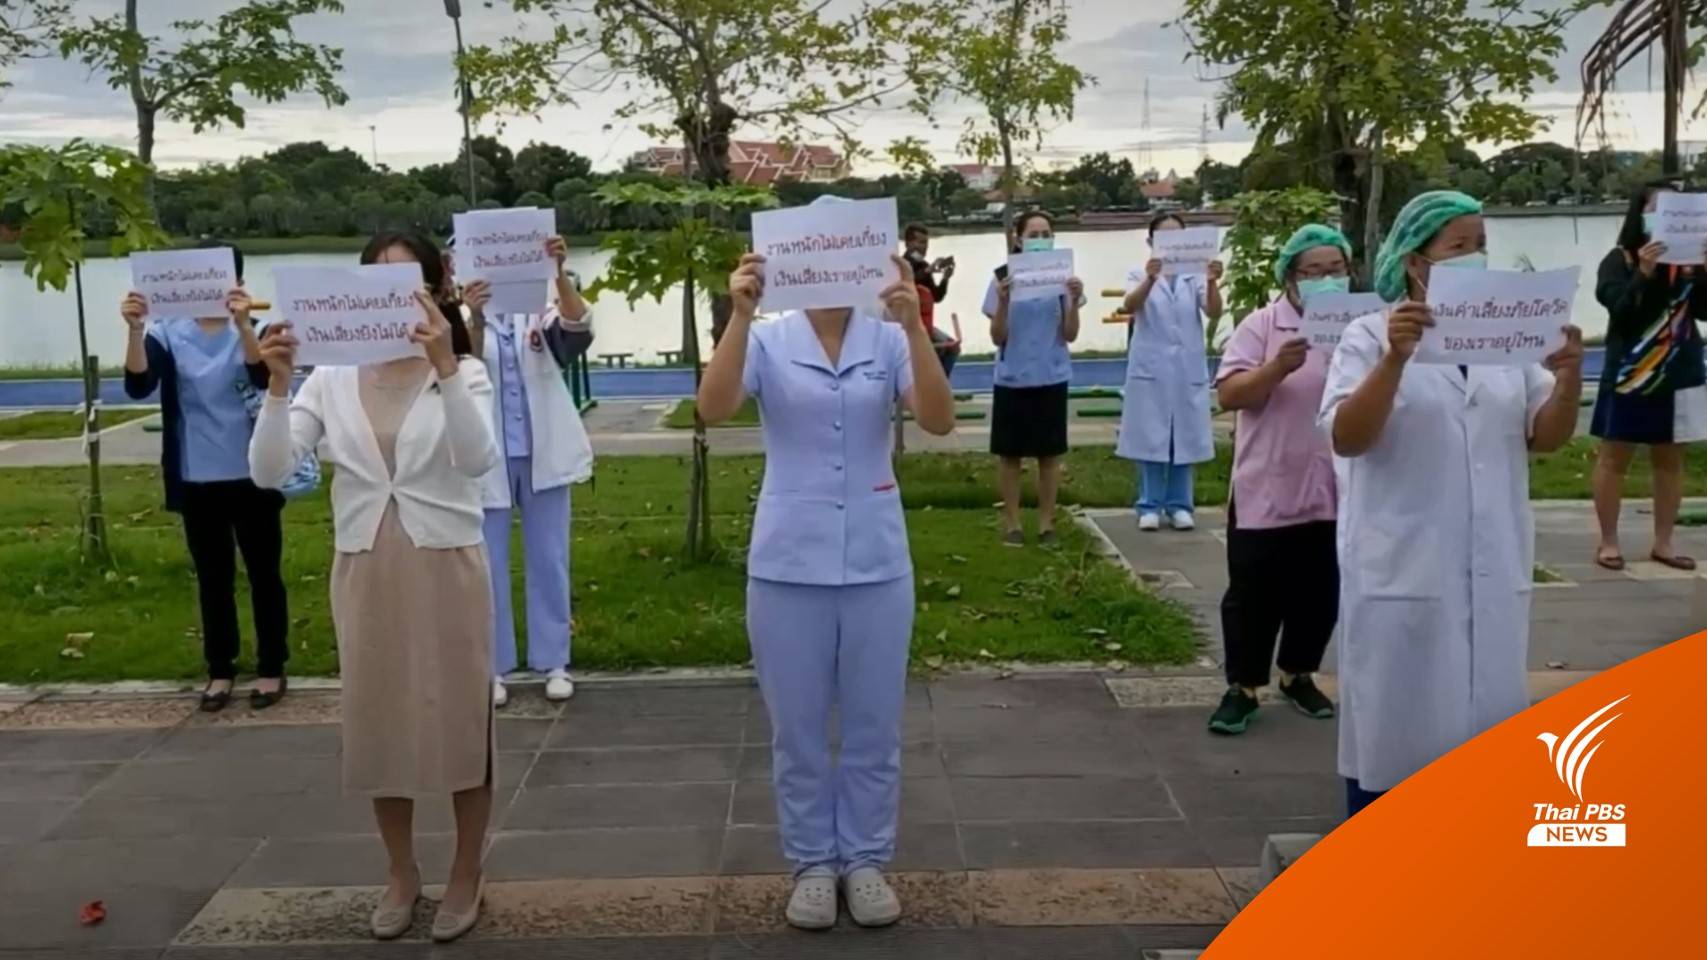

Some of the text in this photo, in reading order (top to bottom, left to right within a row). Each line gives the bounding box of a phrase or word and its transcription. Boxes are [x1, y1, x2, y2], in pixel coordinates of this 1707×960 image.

[767, 225, 887, 256] งานหนักไม่เคยเกี่ยง
[774, 265, 884, 287] เงินเสี่ยงเราอยู่ไหน
[293, 288, 414, 313] งานหนักไม่เคยเกี่ยง
[1444, 330, 1545, 353] ของเราอยู่ไหน
